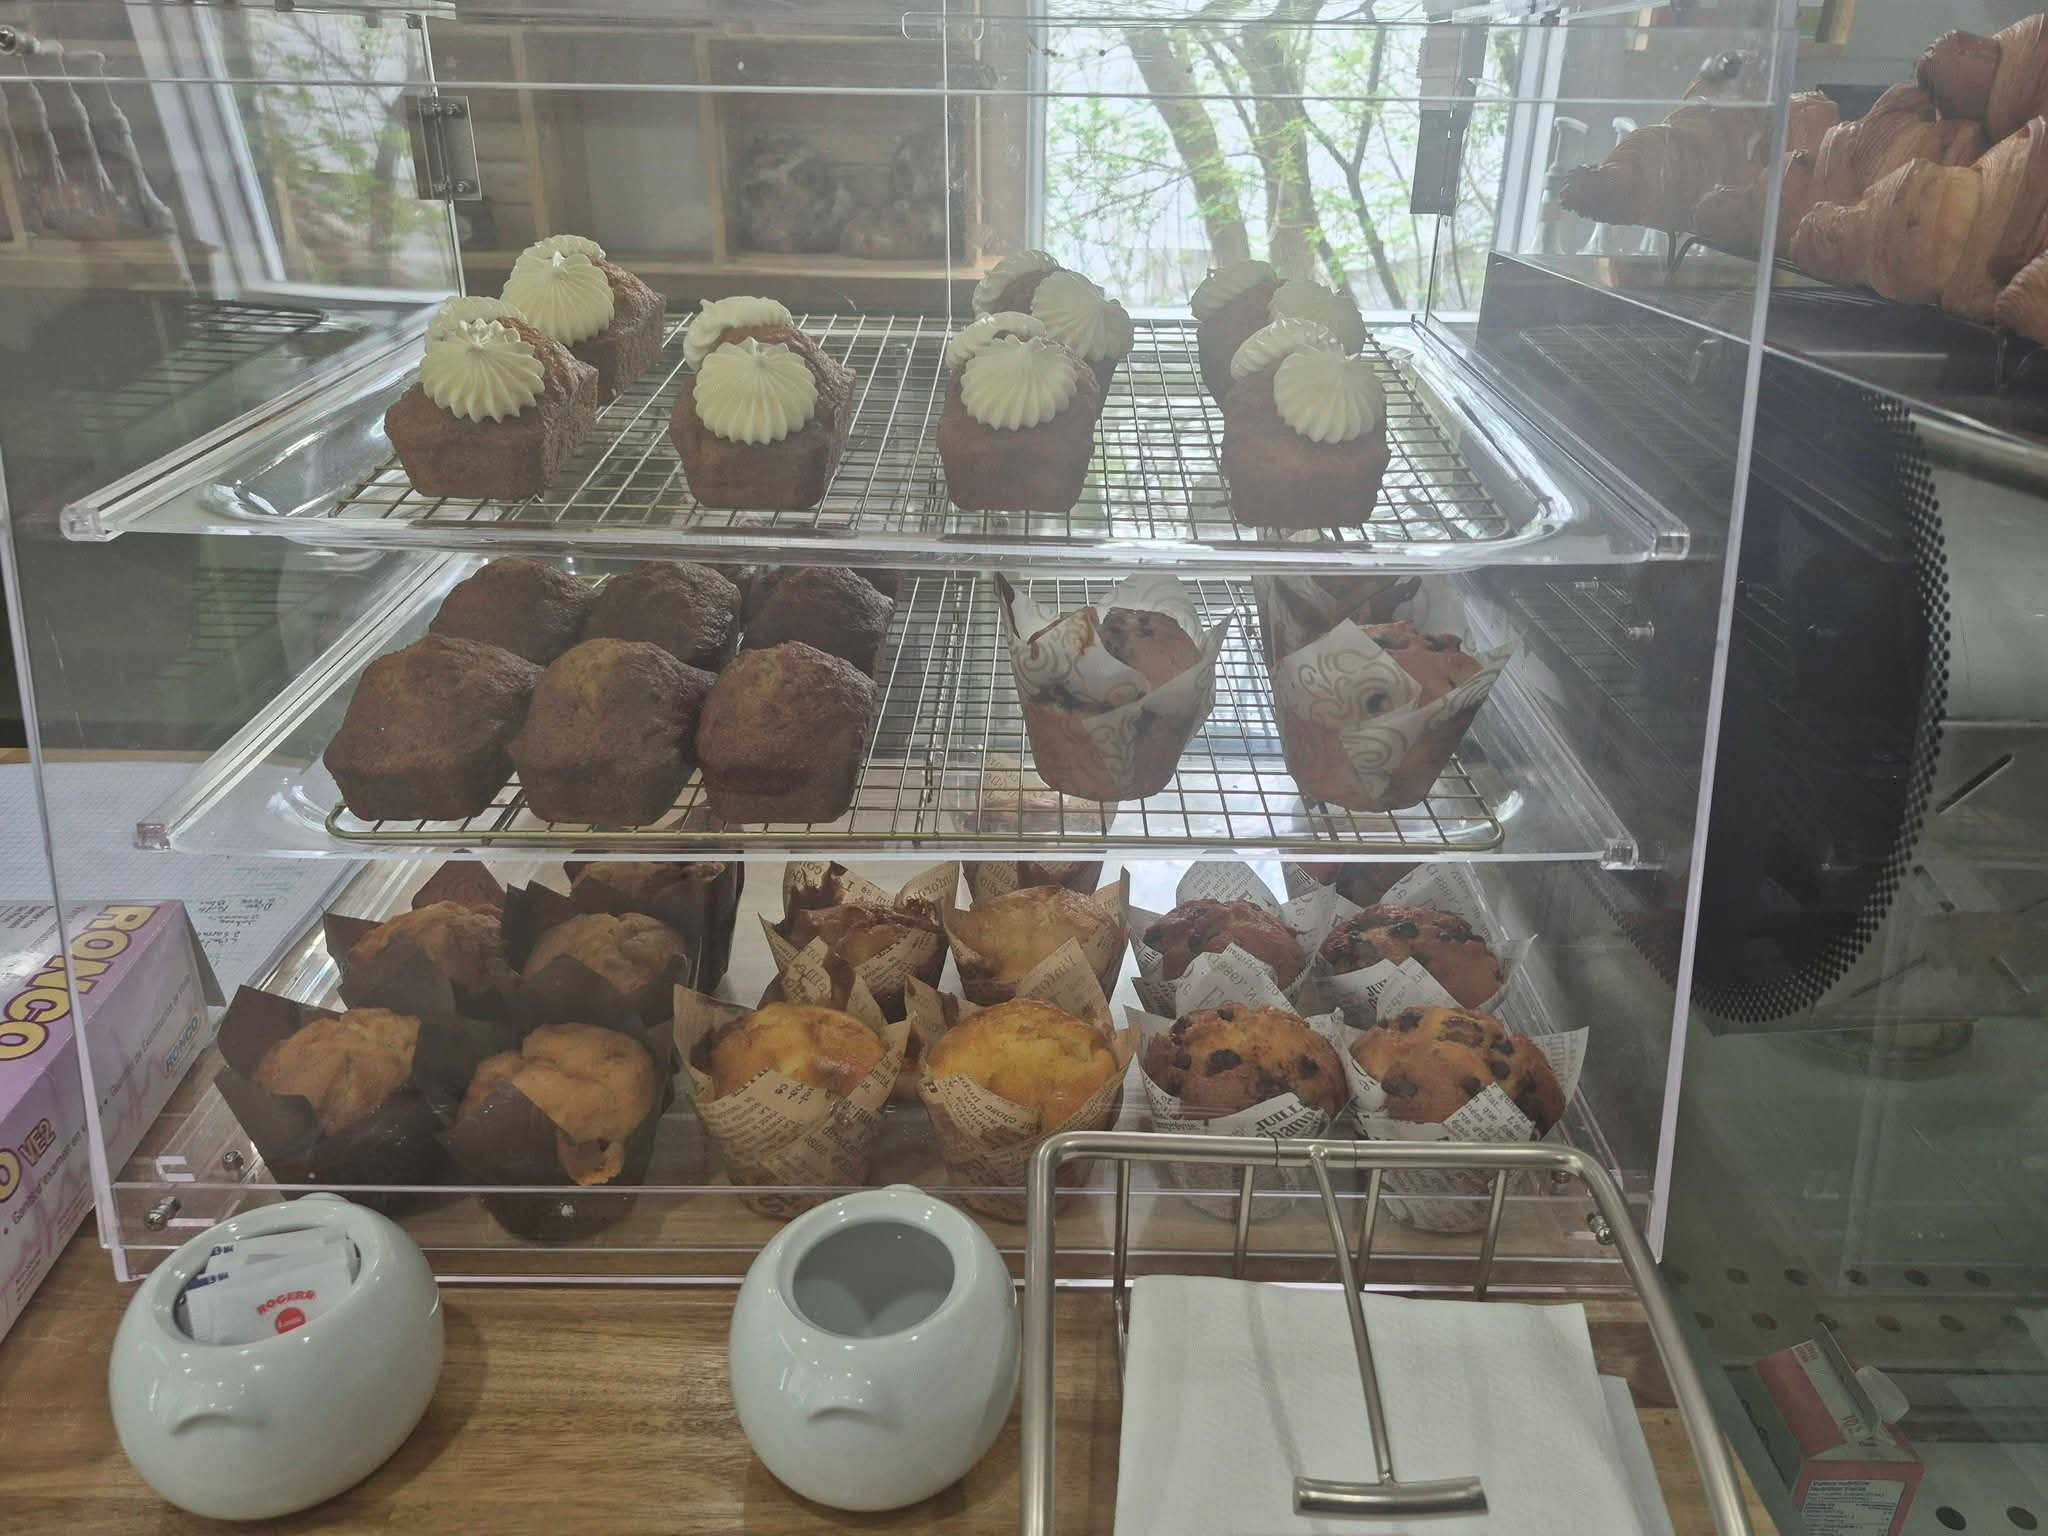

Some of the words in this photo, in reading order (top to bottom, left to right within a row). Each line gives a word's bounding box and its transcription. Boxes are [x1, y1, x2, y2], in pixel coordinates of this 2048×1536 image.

[0, 904, 161, 1061] RONCO
[164, 1014, 202, 1073] RONCO
[18, 1117, 57, 1168] VE2
[255, 1289, 316, 1316] ROGERS
